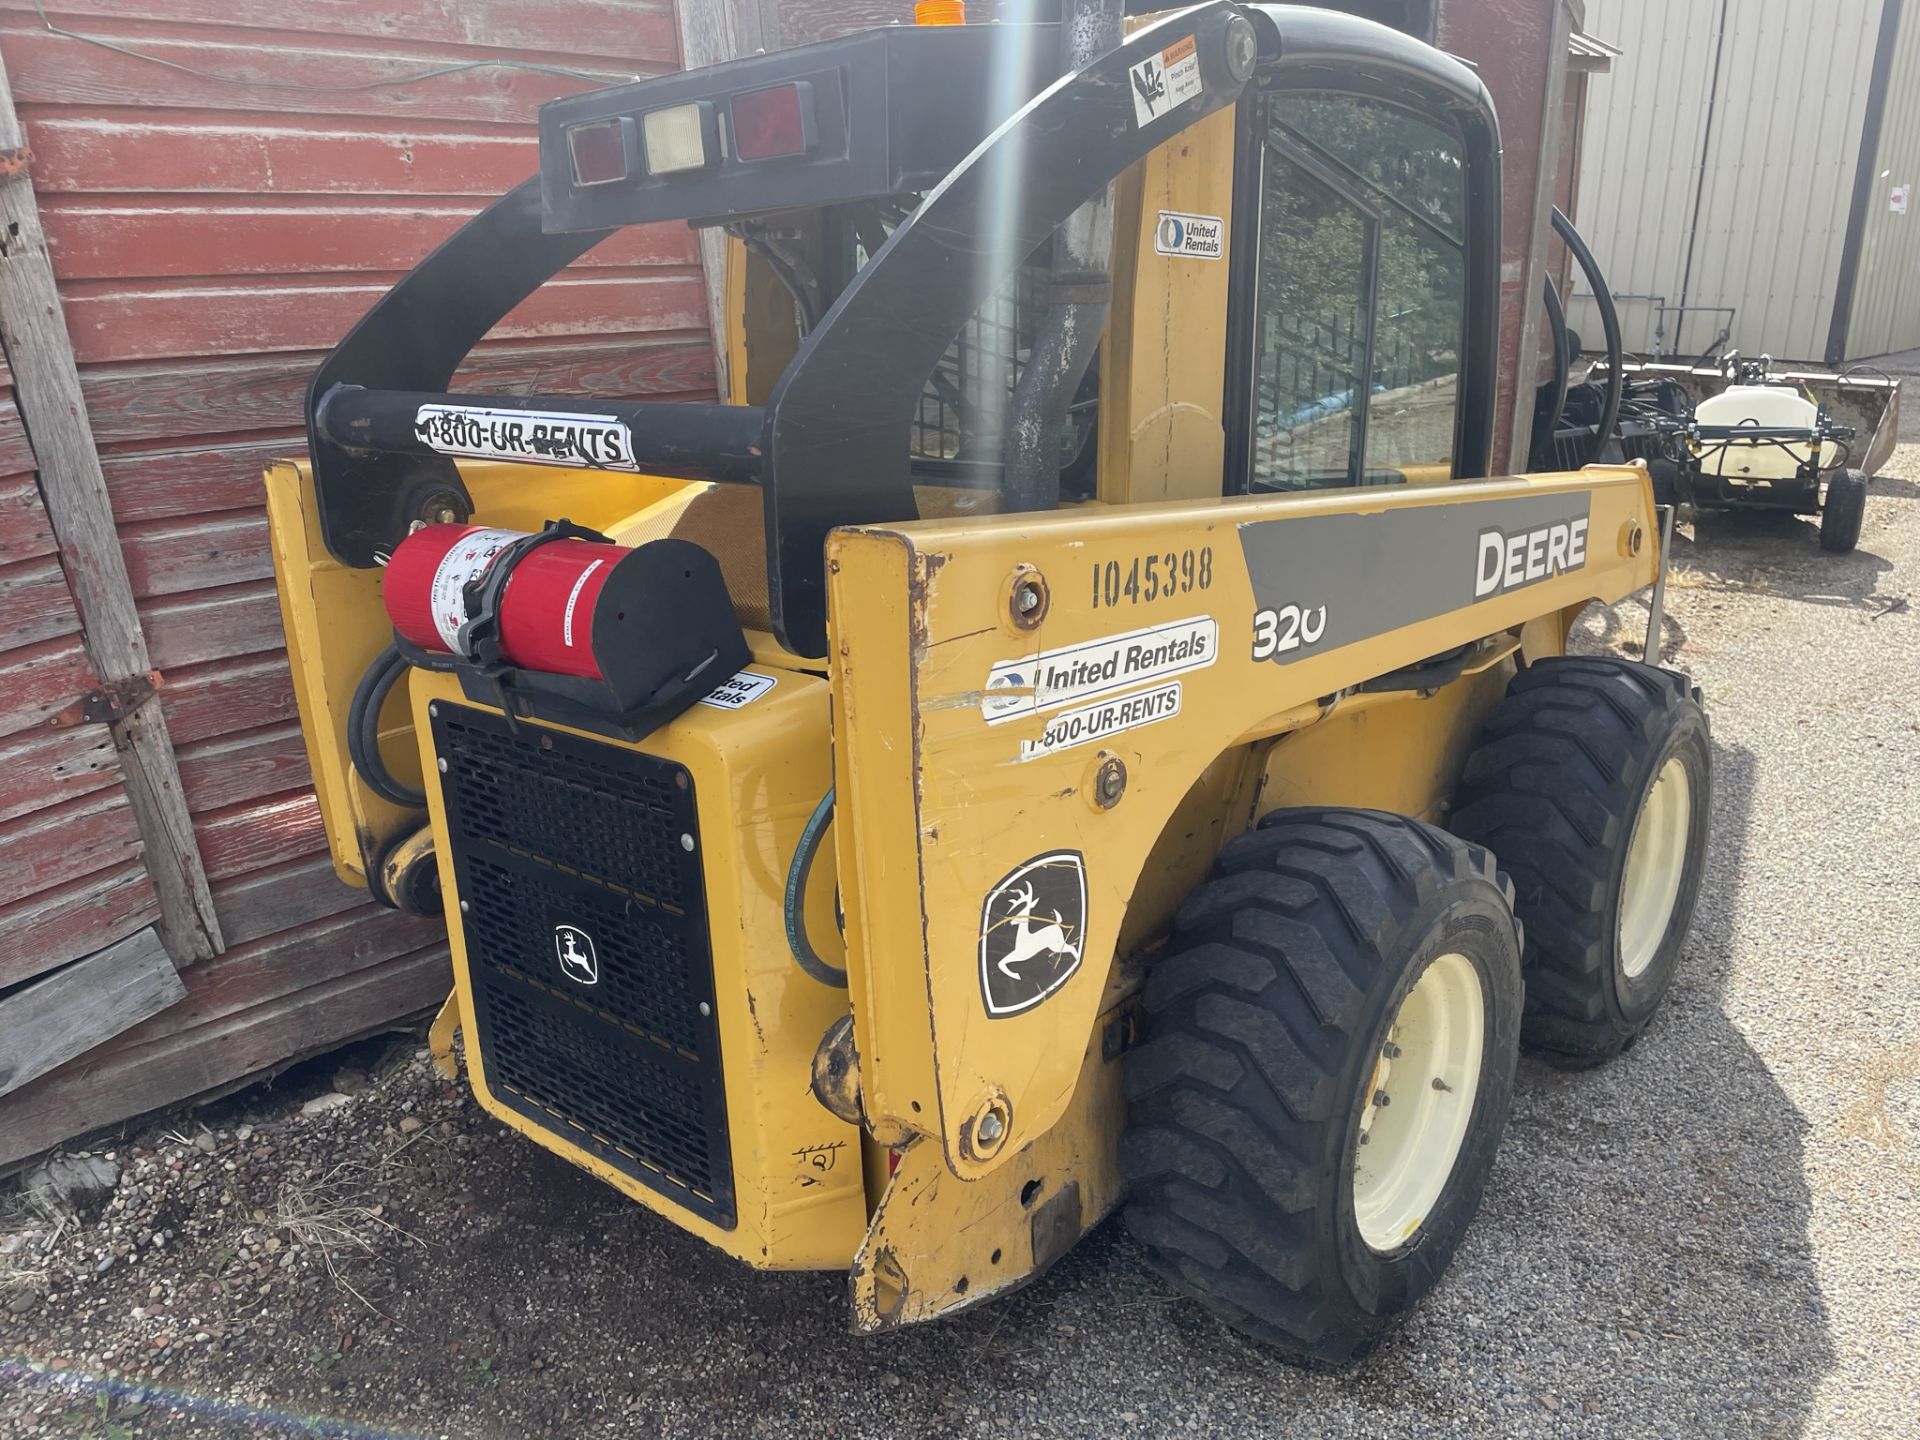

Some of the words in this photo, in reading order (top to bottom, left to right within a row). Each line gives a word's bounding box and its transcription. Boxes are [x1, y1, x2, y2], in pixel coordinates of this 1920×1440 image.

[1184, 236, 1219, 253] Rentals
[1185, 221, 1217, 239] United
[1475, 517, 1589, 598] DEERE
[1092, 546, 1213, 609] 1045398
[1252, 603, 1327, 658] 320
[1034, 650, 1120, 690] United
[1123, 630, 1207, 675] Rentals
[709, 689, 747, 704] tals
[722, 679, 760, 692] ted
